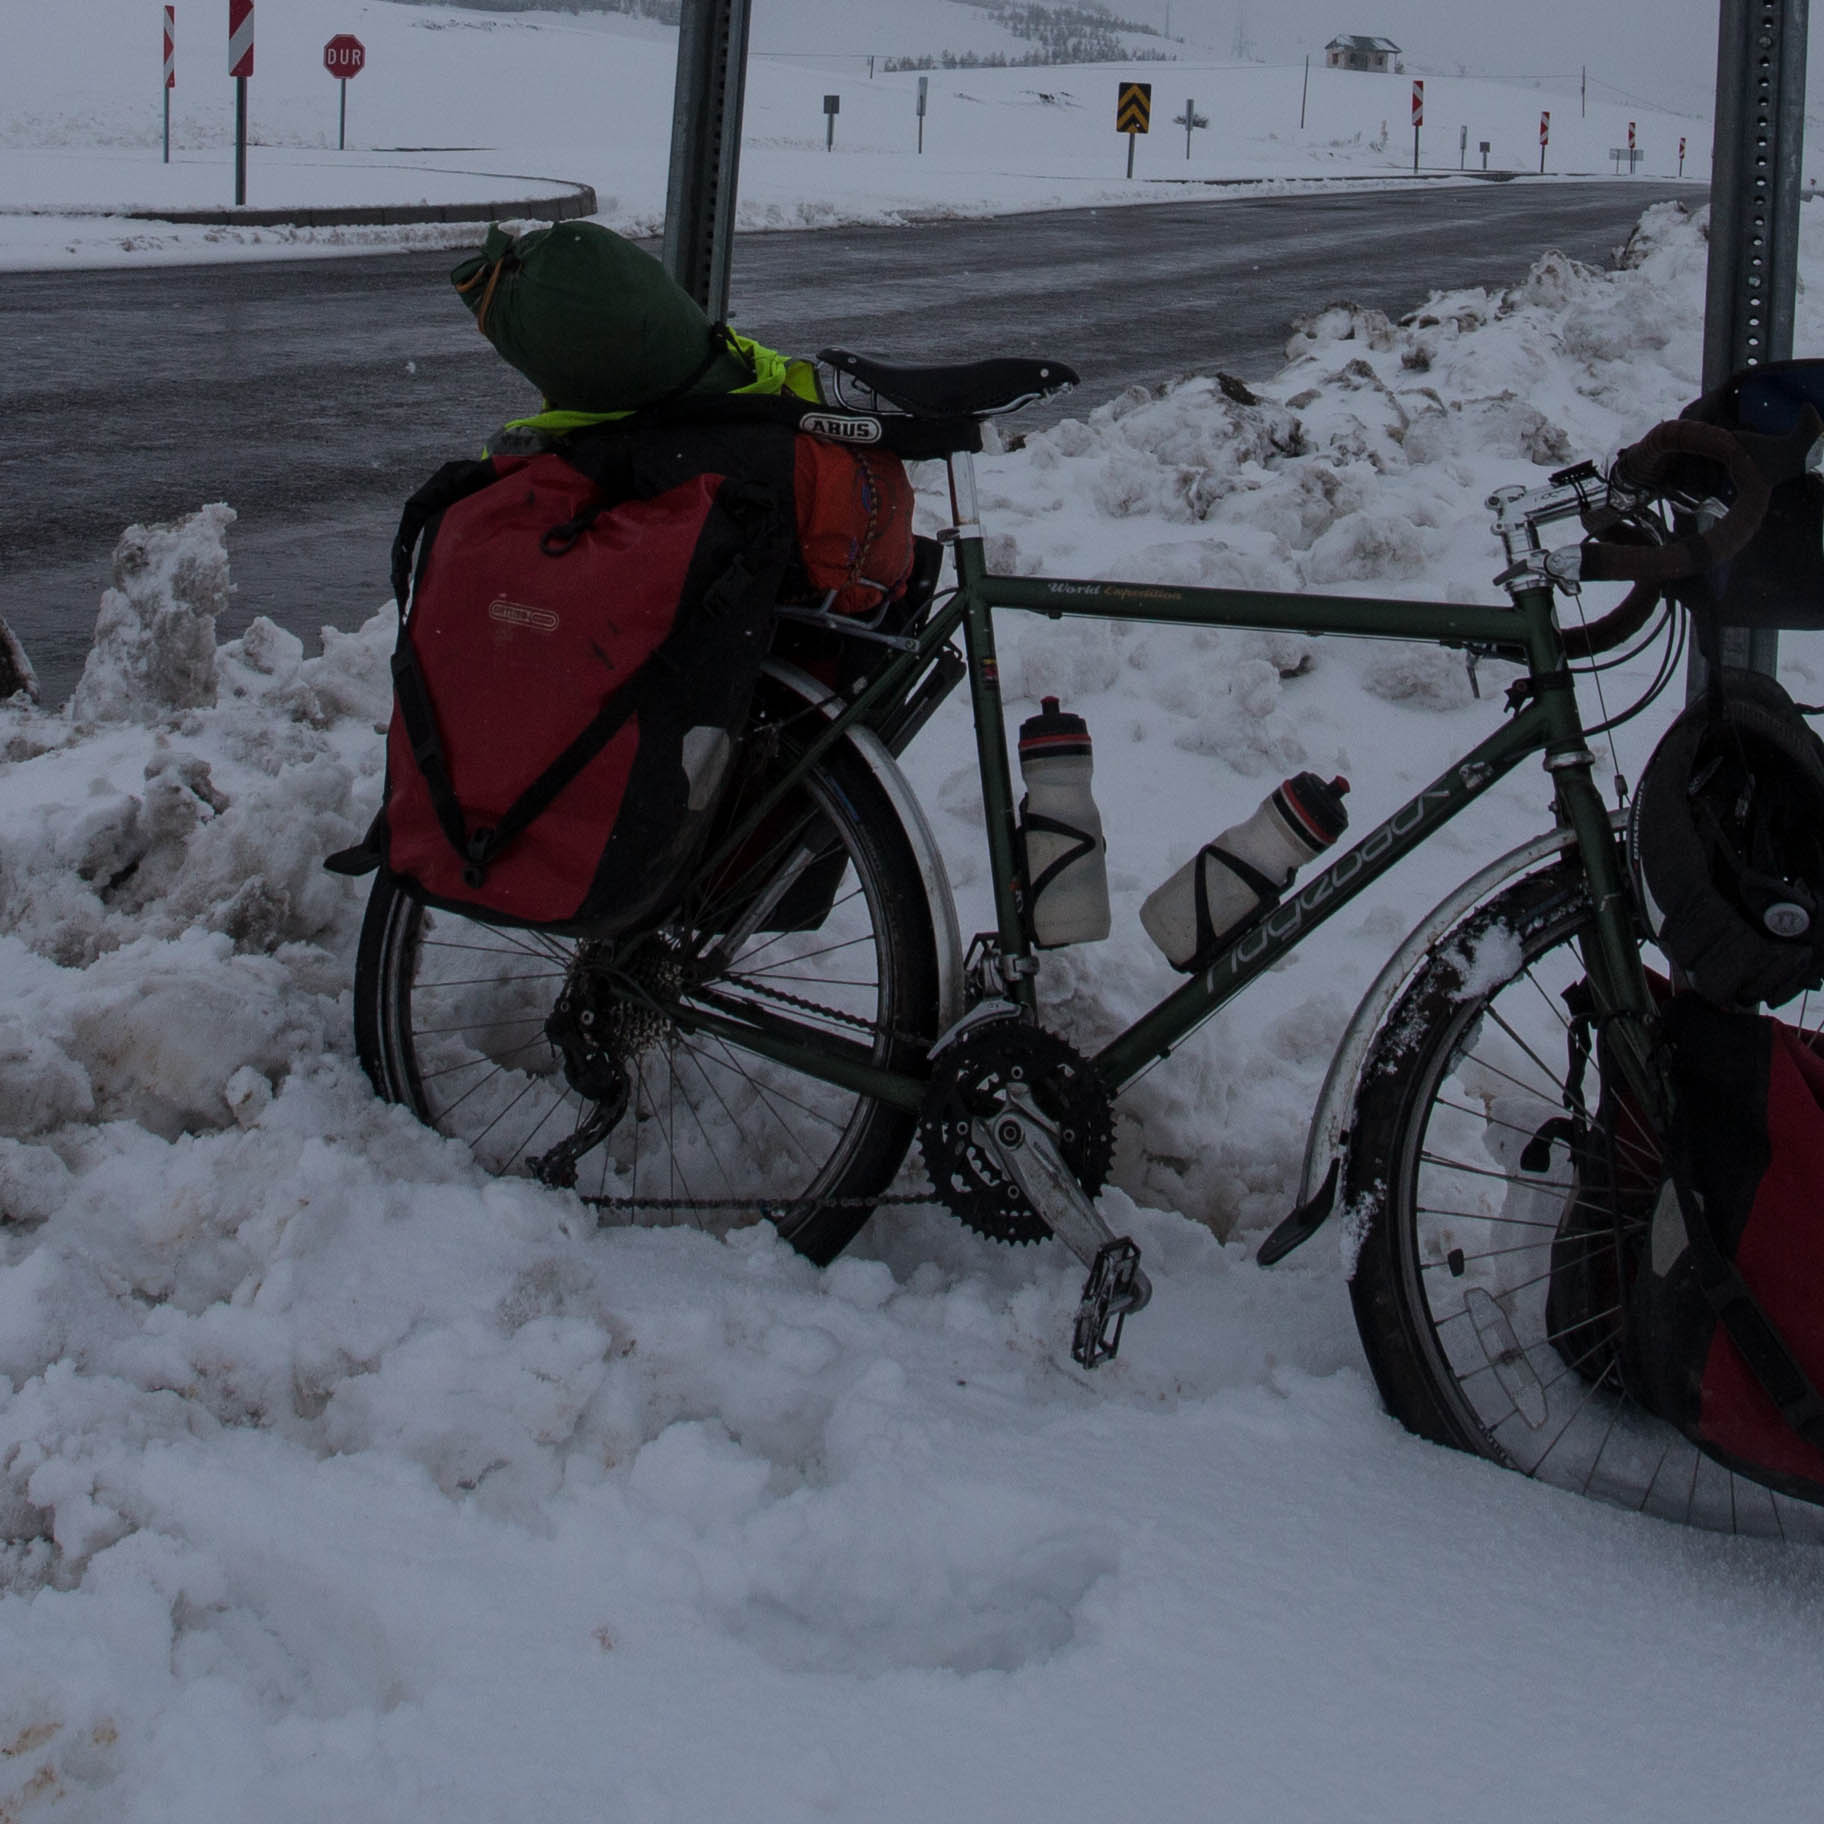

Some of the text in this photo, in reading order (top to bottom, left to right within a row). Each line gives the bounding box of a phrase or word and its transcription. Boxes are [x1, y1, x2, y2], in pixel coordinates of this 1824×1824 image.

[327, 48, 361, 65] DUR
[813, 421, 869, 436] ABUS
[1047, 581, 1101, 595] World
